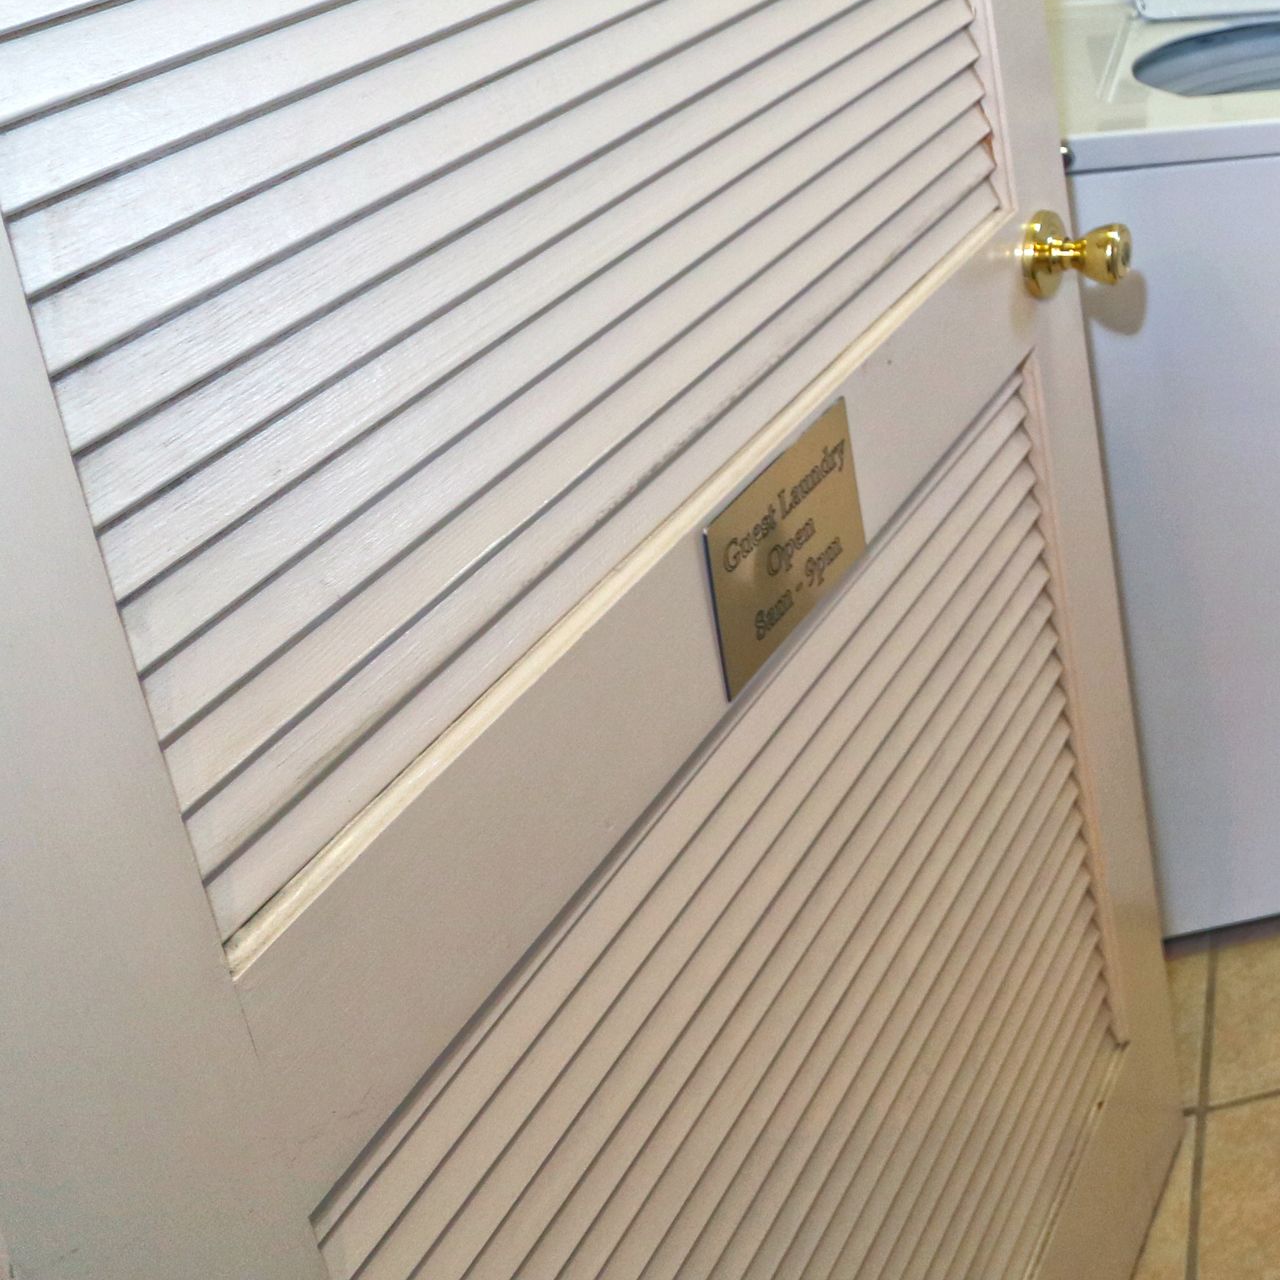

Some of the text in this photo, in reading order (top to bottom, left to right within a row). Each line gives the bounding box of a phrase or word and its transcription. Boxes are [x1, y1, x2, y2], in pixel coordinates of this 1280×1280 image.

[722, 437, 846, 573] Guest Laundry
[766, 516, 817, 578] Open
[804, 535, 844, 588] 9pm
